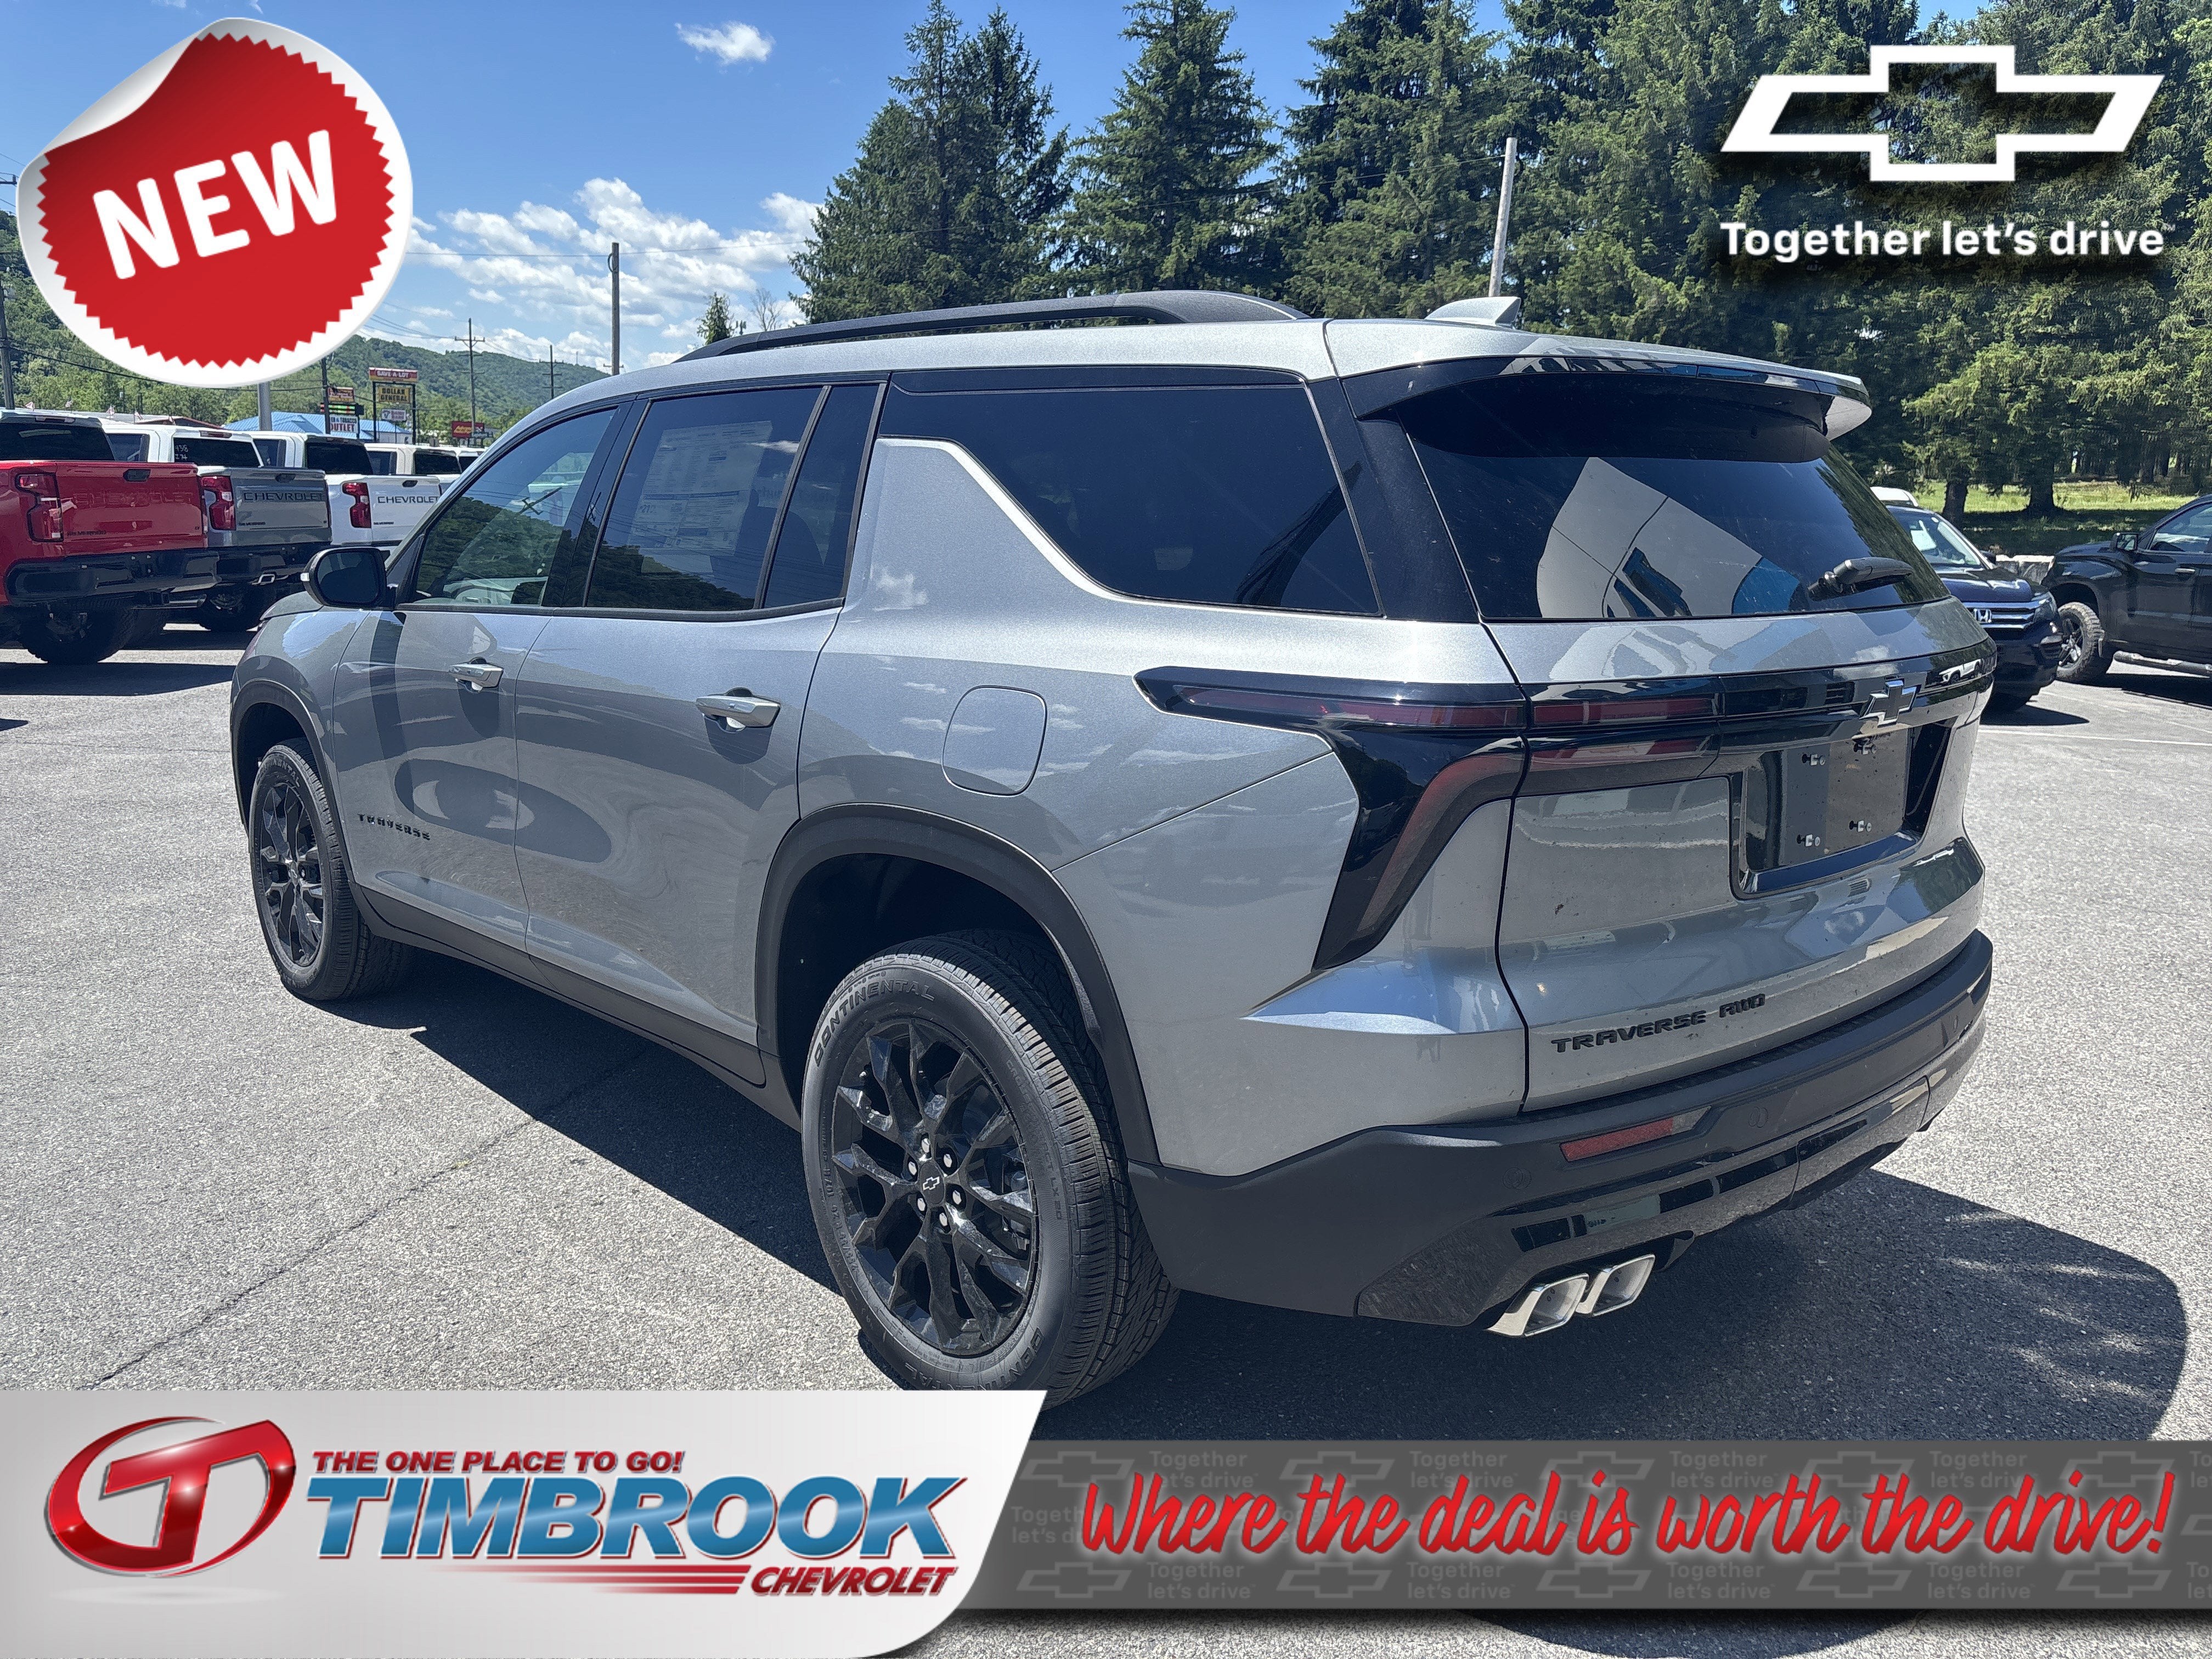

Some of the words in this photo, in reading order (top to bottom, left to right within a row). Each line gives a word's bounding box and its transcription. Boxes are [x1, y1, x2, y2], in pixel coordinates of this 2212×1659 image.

[244, 492, 324, 501] CHEVROLET
[377, 495, 439, 504] CHEVROLET
[358, 812, 431, 841] TRAVERSE
[814, 979, 935, 1067] CONTINENTAL
[1551, 1010, 1707, 1053] TRAVERSE
[1719, 994, 1765, 1018] AWD
